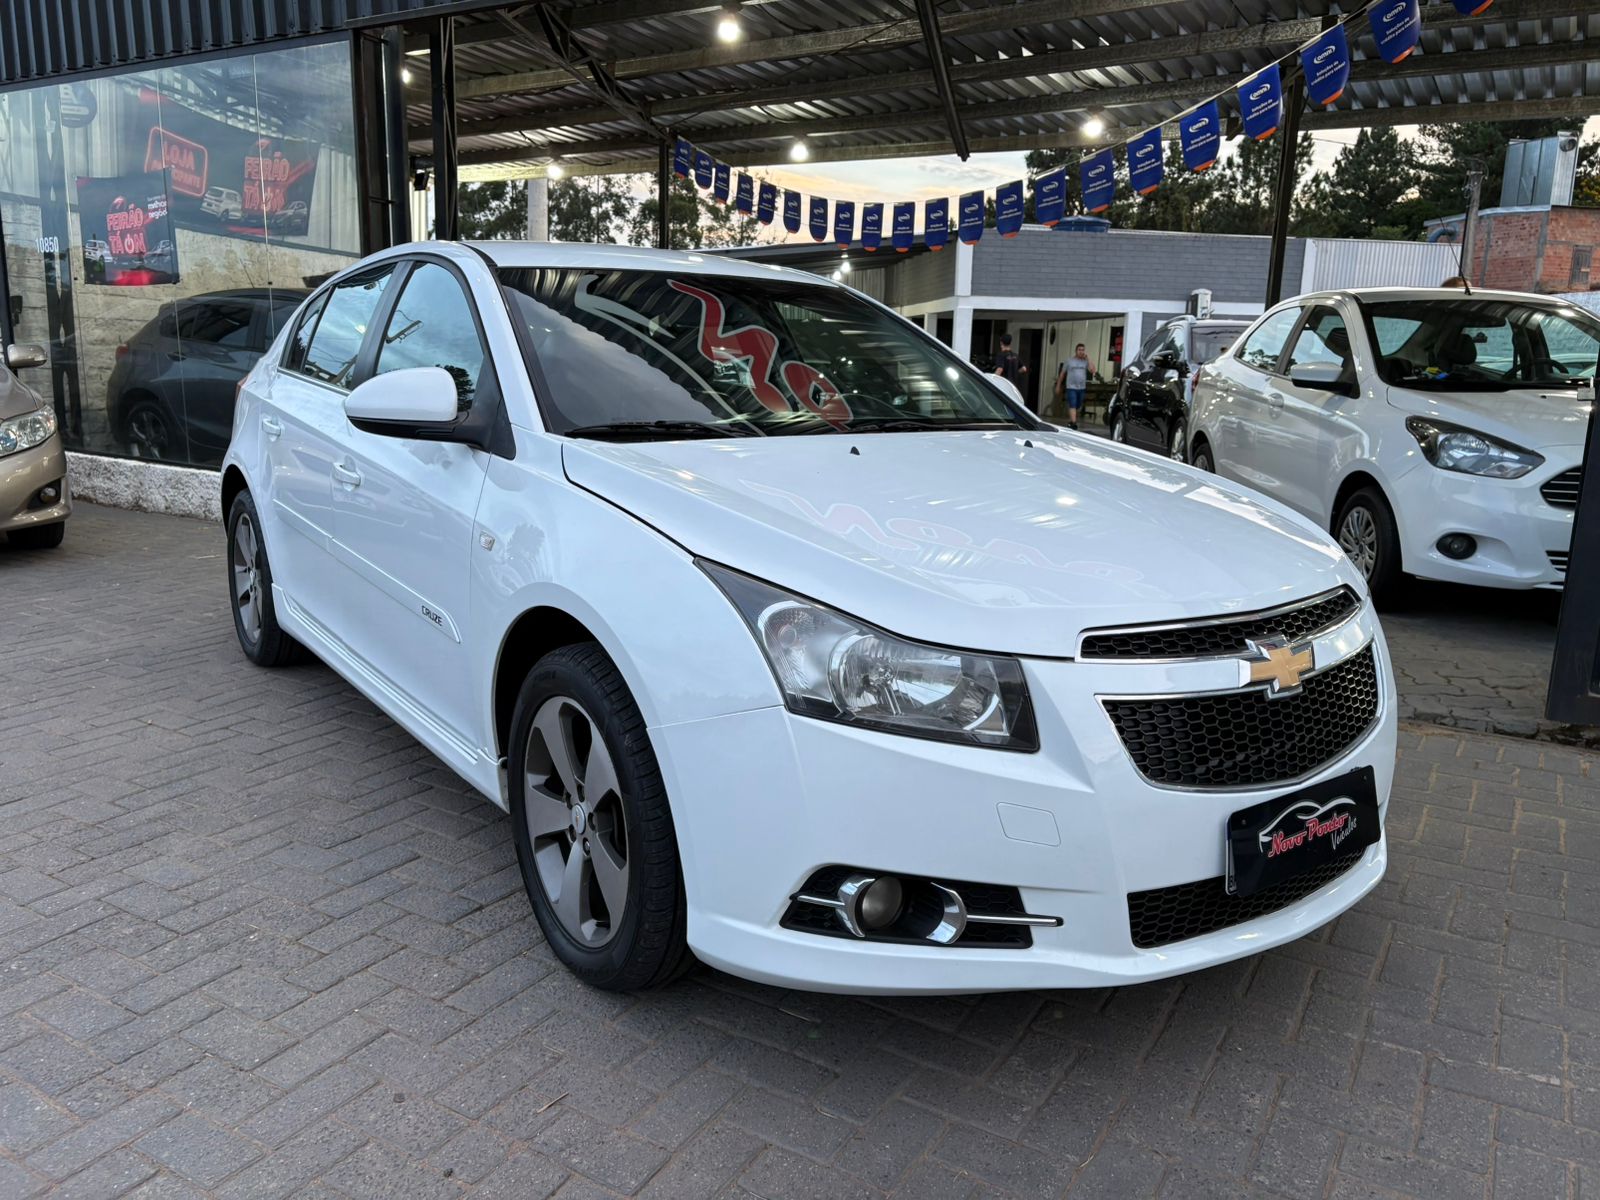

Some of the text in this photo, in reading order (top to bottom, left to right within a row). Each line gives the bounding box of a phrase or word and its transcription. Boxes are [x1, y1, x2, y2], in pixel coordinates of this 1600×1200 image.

[1315, 47, 1334, 62] omni
[164, 141, 195, 171] LOJA
[106, 203, 144, 231] FEIRÃO
[35, 236, 59, 253] 10850
[108, 231, 125, 254] TÁ
[421, 605, 443, 626] CRUZE
[1268, 812, 1348, 857] Novo Ponto
